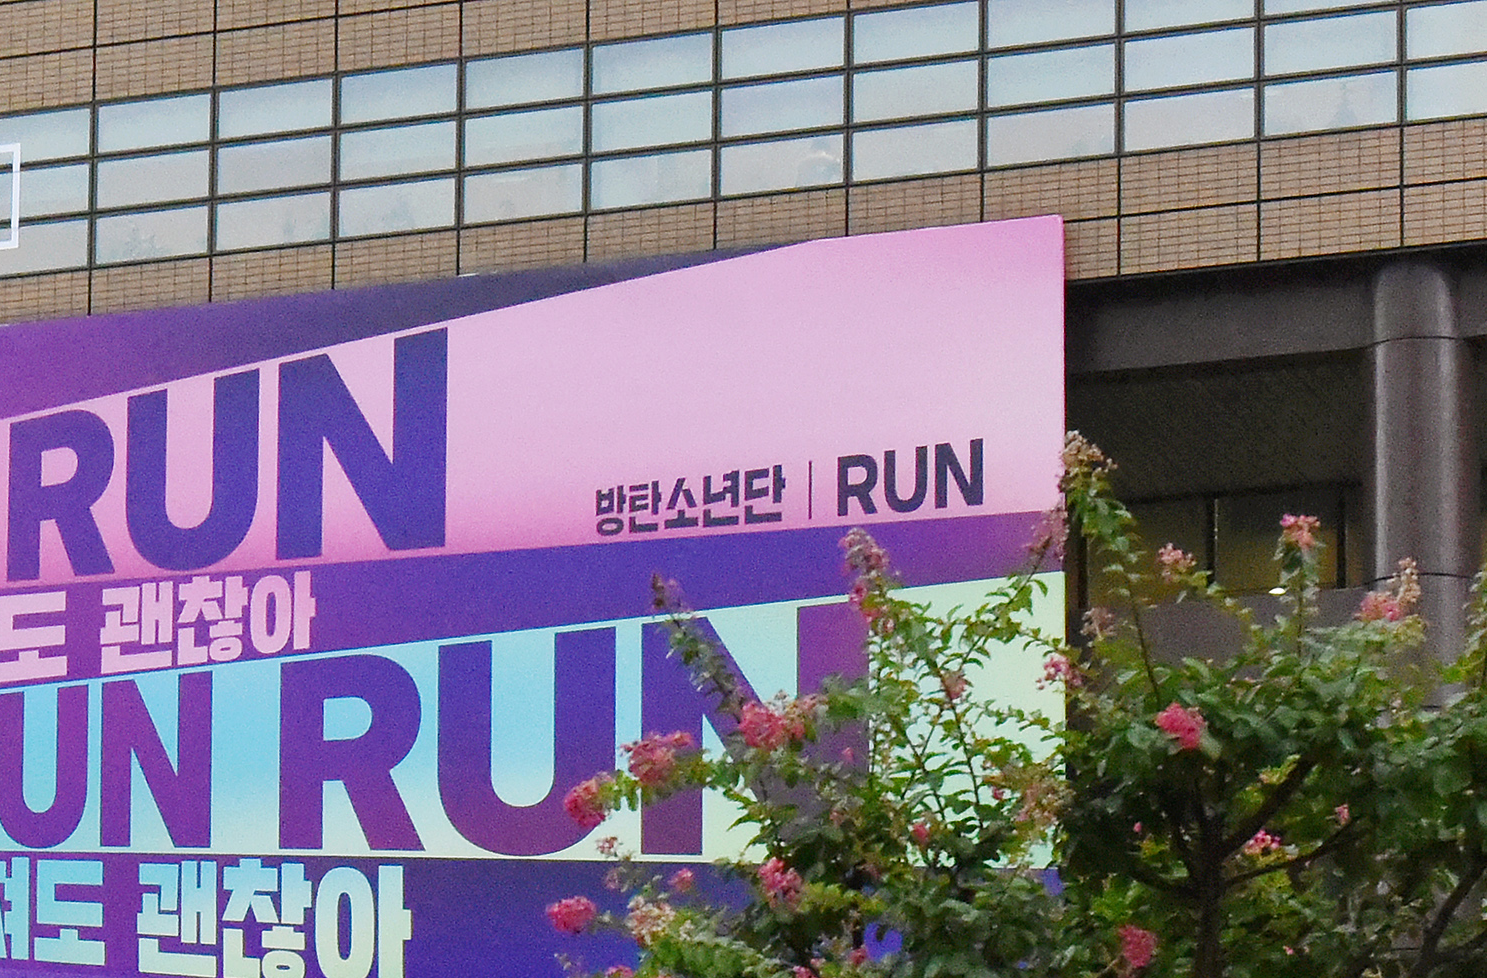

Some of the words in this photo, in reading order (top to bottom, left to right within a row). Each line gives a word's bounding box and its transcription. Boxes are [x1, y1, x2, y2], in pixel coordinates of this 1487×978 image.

[6, 327, 448, 583] RUN
[594, 464, 786, 537] 방탄소년단
[837, 438, 985, 517] RUN
[100, 571, 316, 675] 괜찮아
[279, 600, 868, 856] RUN
